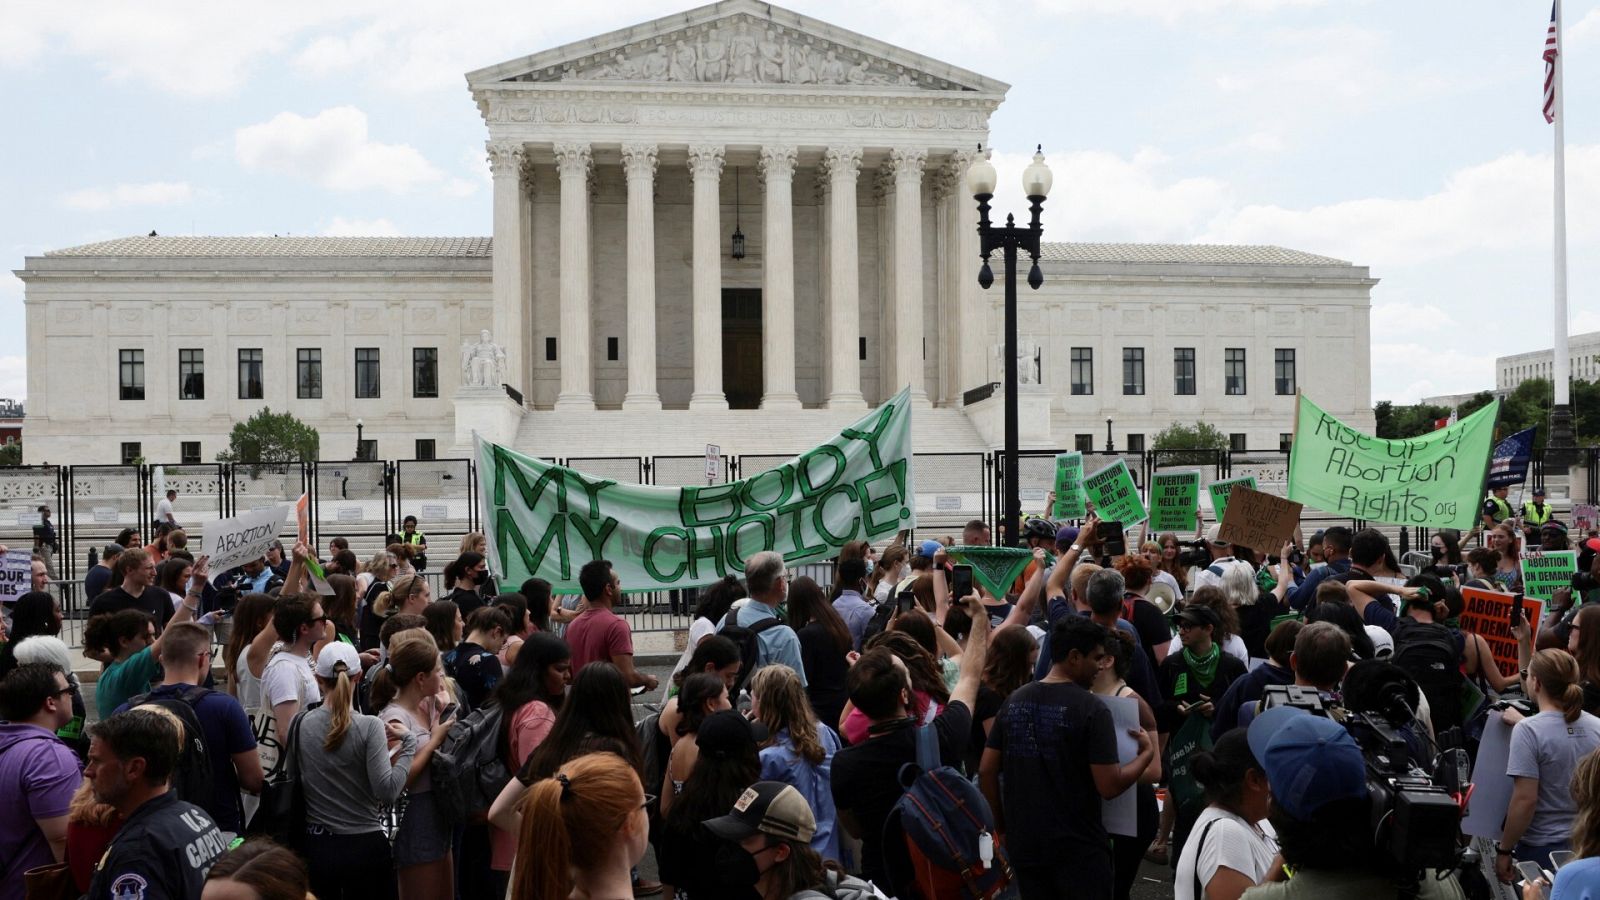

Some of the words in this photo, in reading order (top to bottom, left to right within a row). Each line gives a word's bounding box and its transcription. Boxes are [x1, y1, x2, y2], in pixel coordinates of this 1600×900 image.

[701, 110, 753, 122] JUSTICE
[1315, 413, 1371, 450] Rise
[1443, 423, 1466, 452] 4
[493, 443, 617, 519] MY
[678, 404, 895, 528] BODY
[1325, 446, 1455, 484] Abortion
[1087, 464, 1123, 490] OVERTURN
[1157, 475, 1195, 486] OVERTURN
[1099, 484, 1114, 496] ROE
[1164, 487, 1180, 497] ROE
[1213, 479, 1252, 496] OVERRN
[1099, 493, 1117, 509] HELL
[1117, 487, 1130, 499] NO!
[1158, 497, 1176, 507] HELL
[1178, 497, 1192, 507] NO!
[1270, 497, 1294, 513] NOT
[496, 508, 619, 581] MY
[643, 458, 911, 583] CHOICE!
[1240, 502, 1282, 525] PRO-LIFE
[216, 522, 275, 553] ABORTION
[1222, 523, 1285, 552] PRO-BIRTH
[1520, 551, 1544, 559] LEGAL
[1528, 556, 1568, 568] ABORTION
[1525, 571, 1536, 581] ON
[1538, 571, 1573, 581] DEMAND
[1529, 586, 1535, 595] &
[1467, 596, 1533, 621] ABORTN
[1460, 615, 1478, 633] ON
[185, 826, 228, 869] CAPITO
